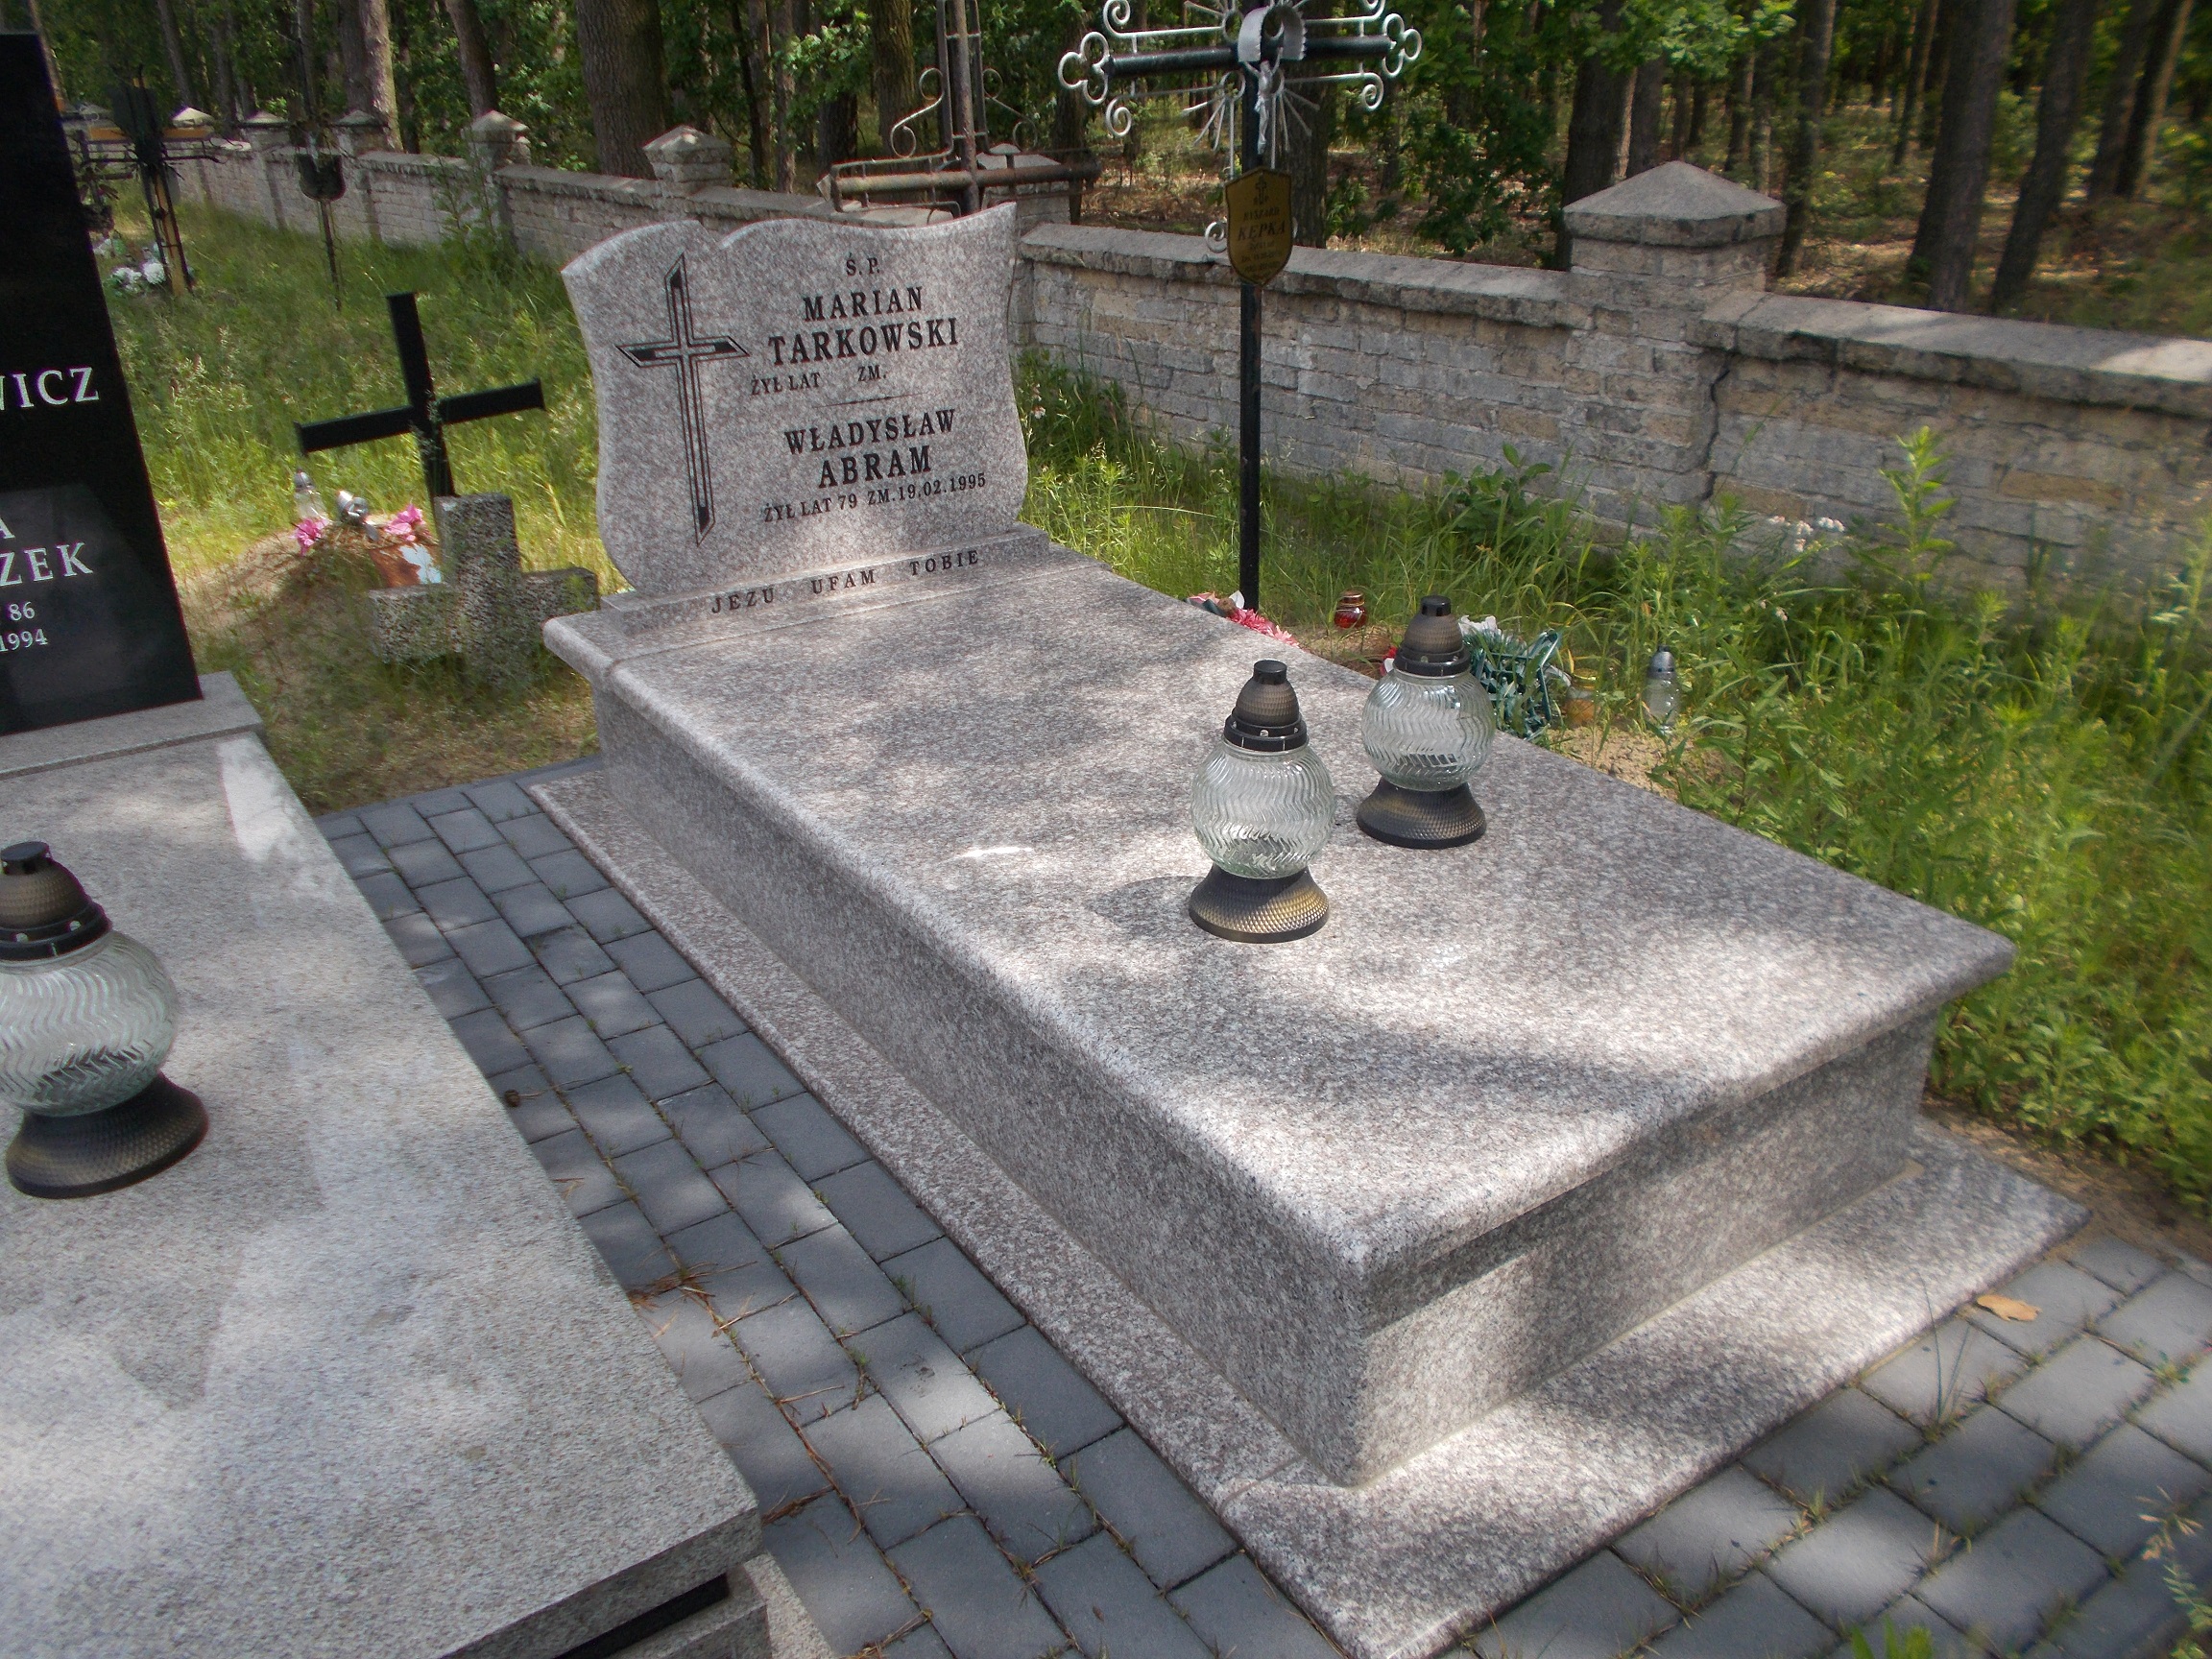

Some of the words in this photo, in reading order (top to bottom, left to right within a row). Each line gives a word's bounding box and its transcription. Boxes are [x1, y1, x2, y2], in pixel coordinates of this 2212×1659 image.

[803, 286, 923, 322] MARIAN
[768, 317, 959, 366] TARKOWSKI
[0, 367, 100, 411] ICZ
[788, 372, 821, 392] LAT
[857, 364, 887, 382] ZM.
[783, 408, 955, 455] WŁADYSŁAW
[818, 445, 931, 489] ABRAM
[801, 497, 832, 517] LAT
[837, 493, 858, 511] 79
[711, 587, 774, 613] JEZU
[810, 568, 876, 594] UFAM
[910, 549, 979, 576] TOBIE
[9, 601, 36, 621] 86
